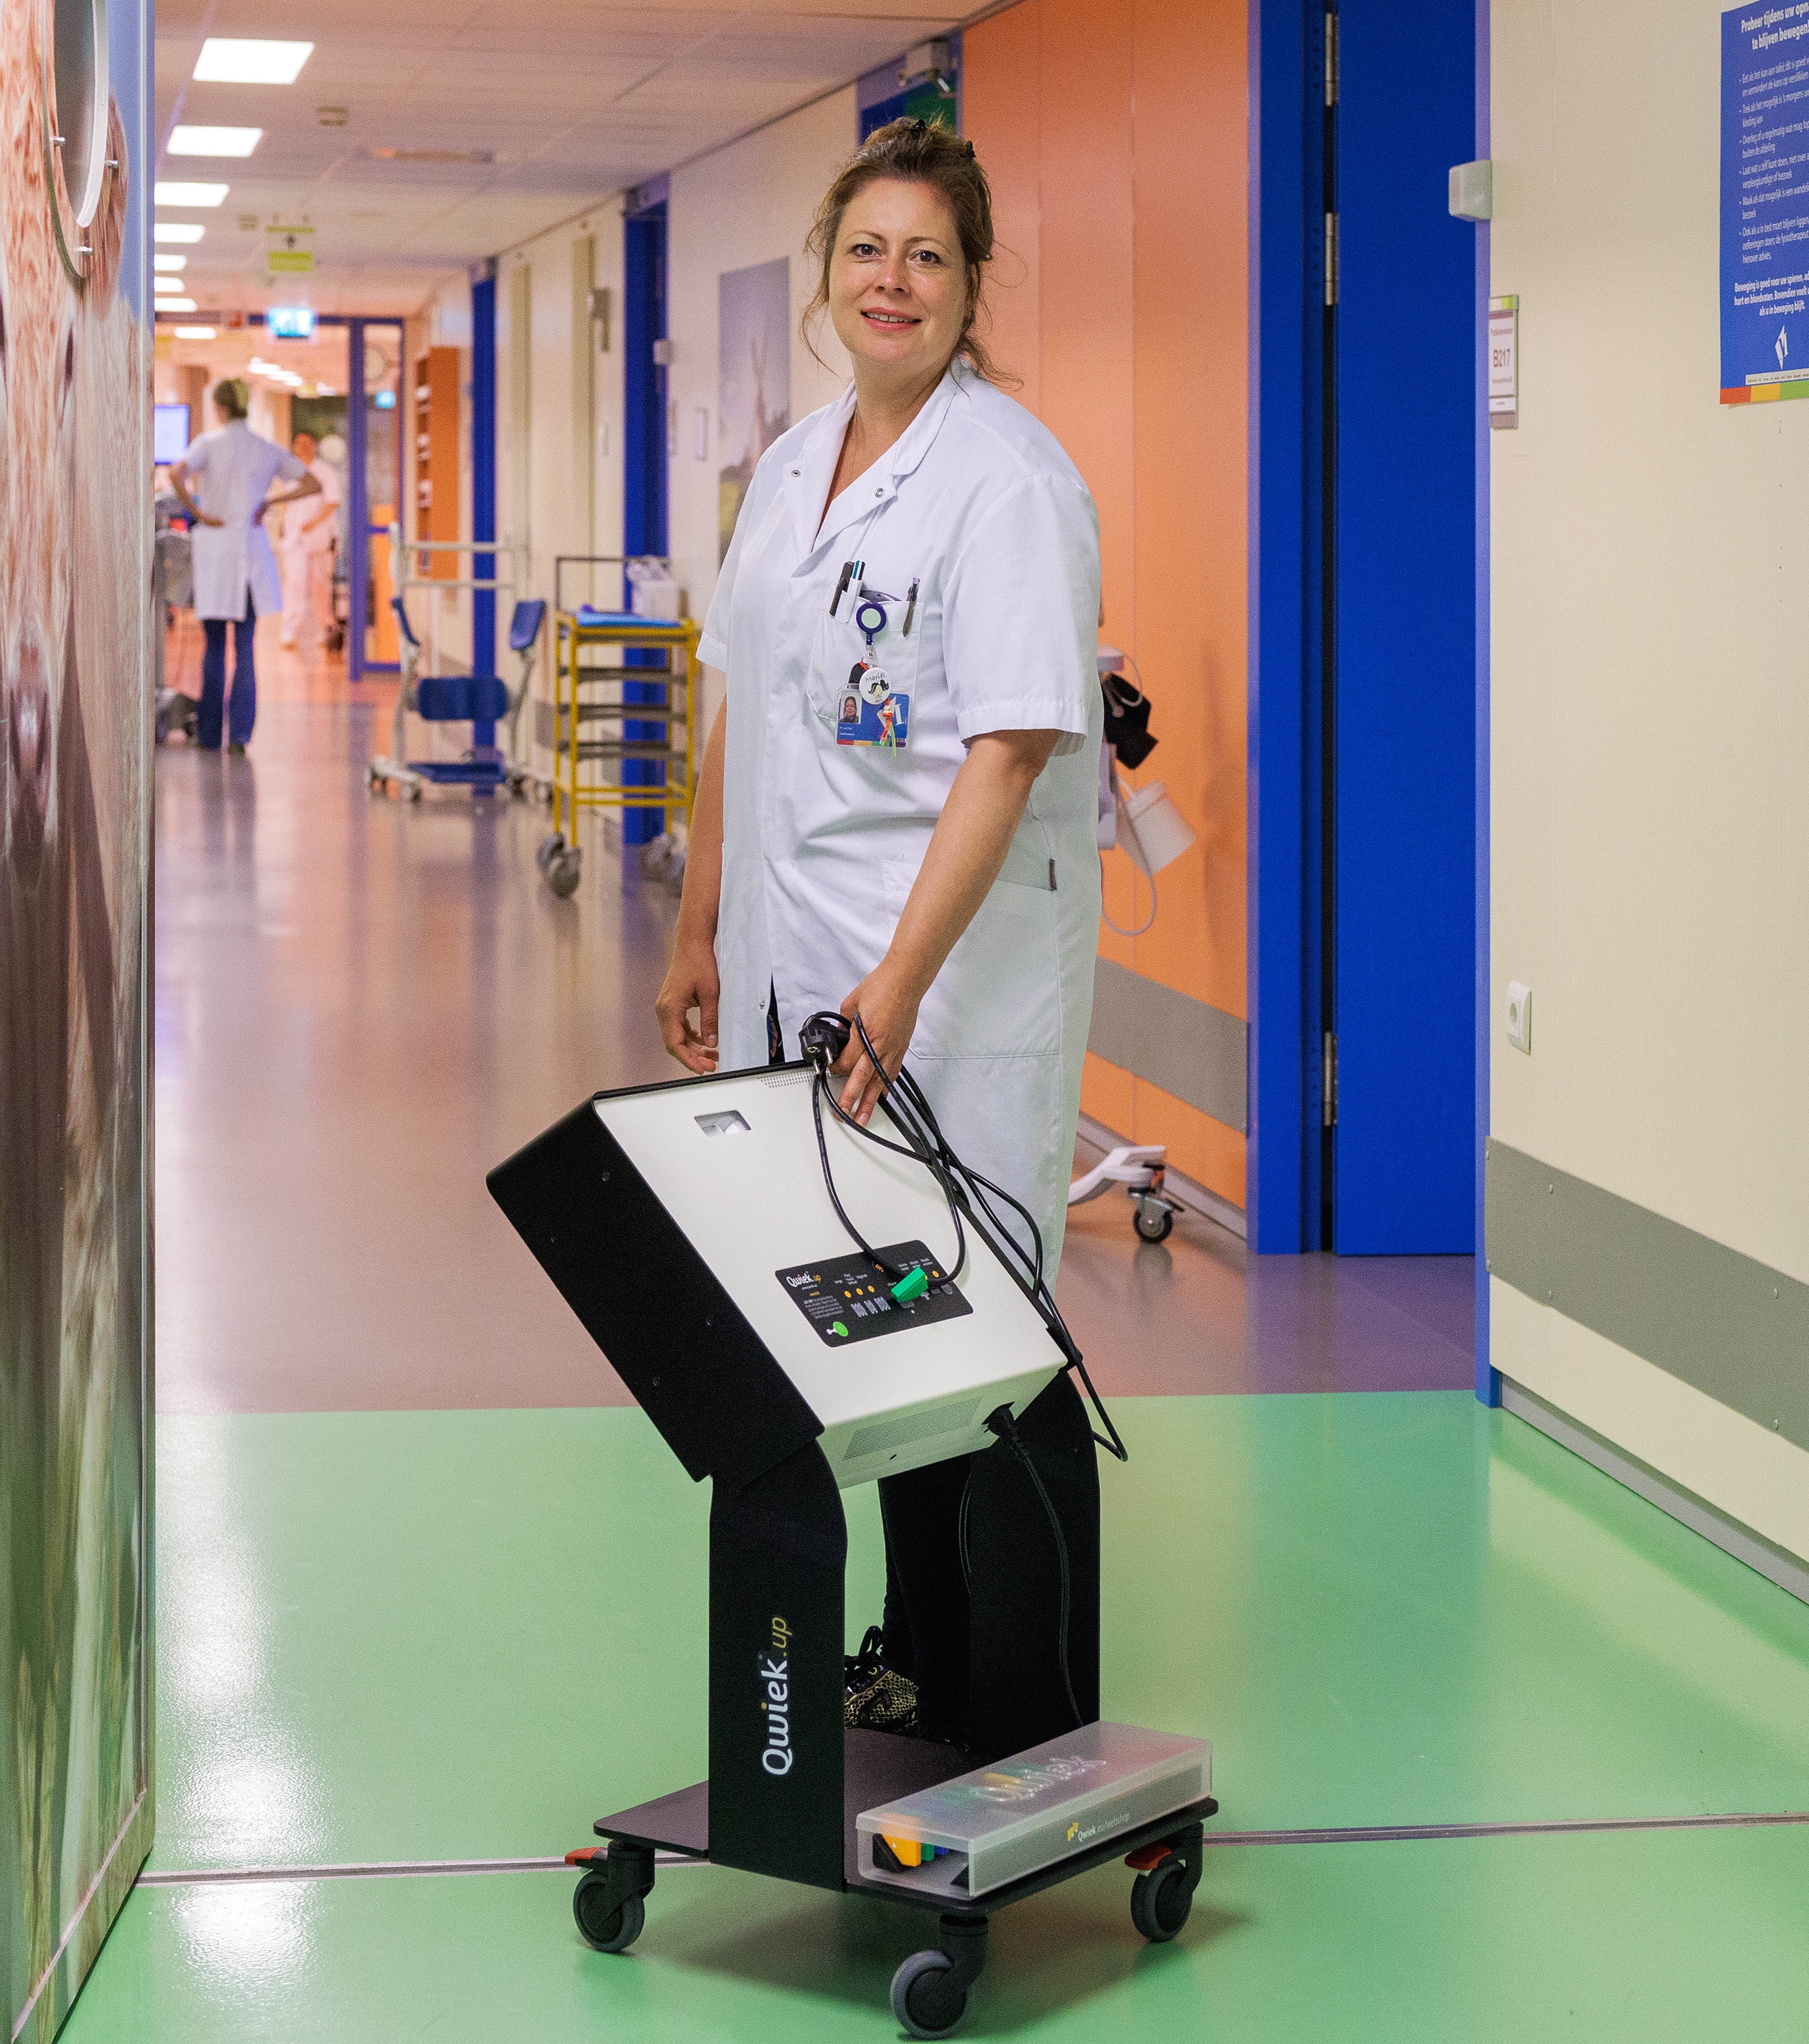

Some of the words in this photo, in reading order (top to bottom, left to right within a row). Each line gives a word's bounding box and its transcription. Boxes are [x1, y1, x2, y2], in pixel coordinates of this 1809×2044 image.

[1742, 17, 1763, 32] Probeer
[1764, 9, 1784, 28] tijdens
[1784, 6, 1794, 18] uw
[1795, 2, 1809, 18] opn
[1752, 38, 1758, 50] te
[1758, 32, 1778, 50] blijven
[1735, 281, 1755, 293] Beweging
[1756, 280, 1759, 288] is
[1760, 278, 1770, 290] goed
[1734, 296, 1744, 305] hart
[1775, 287, 1796, 300] Bovendien
[1796, 285, 1807, 295] voelt
[1769, 305, 1774, 314] in
[1774, 302, 1794, 315] beweging
[1493, 348, 1511, 367] B217
